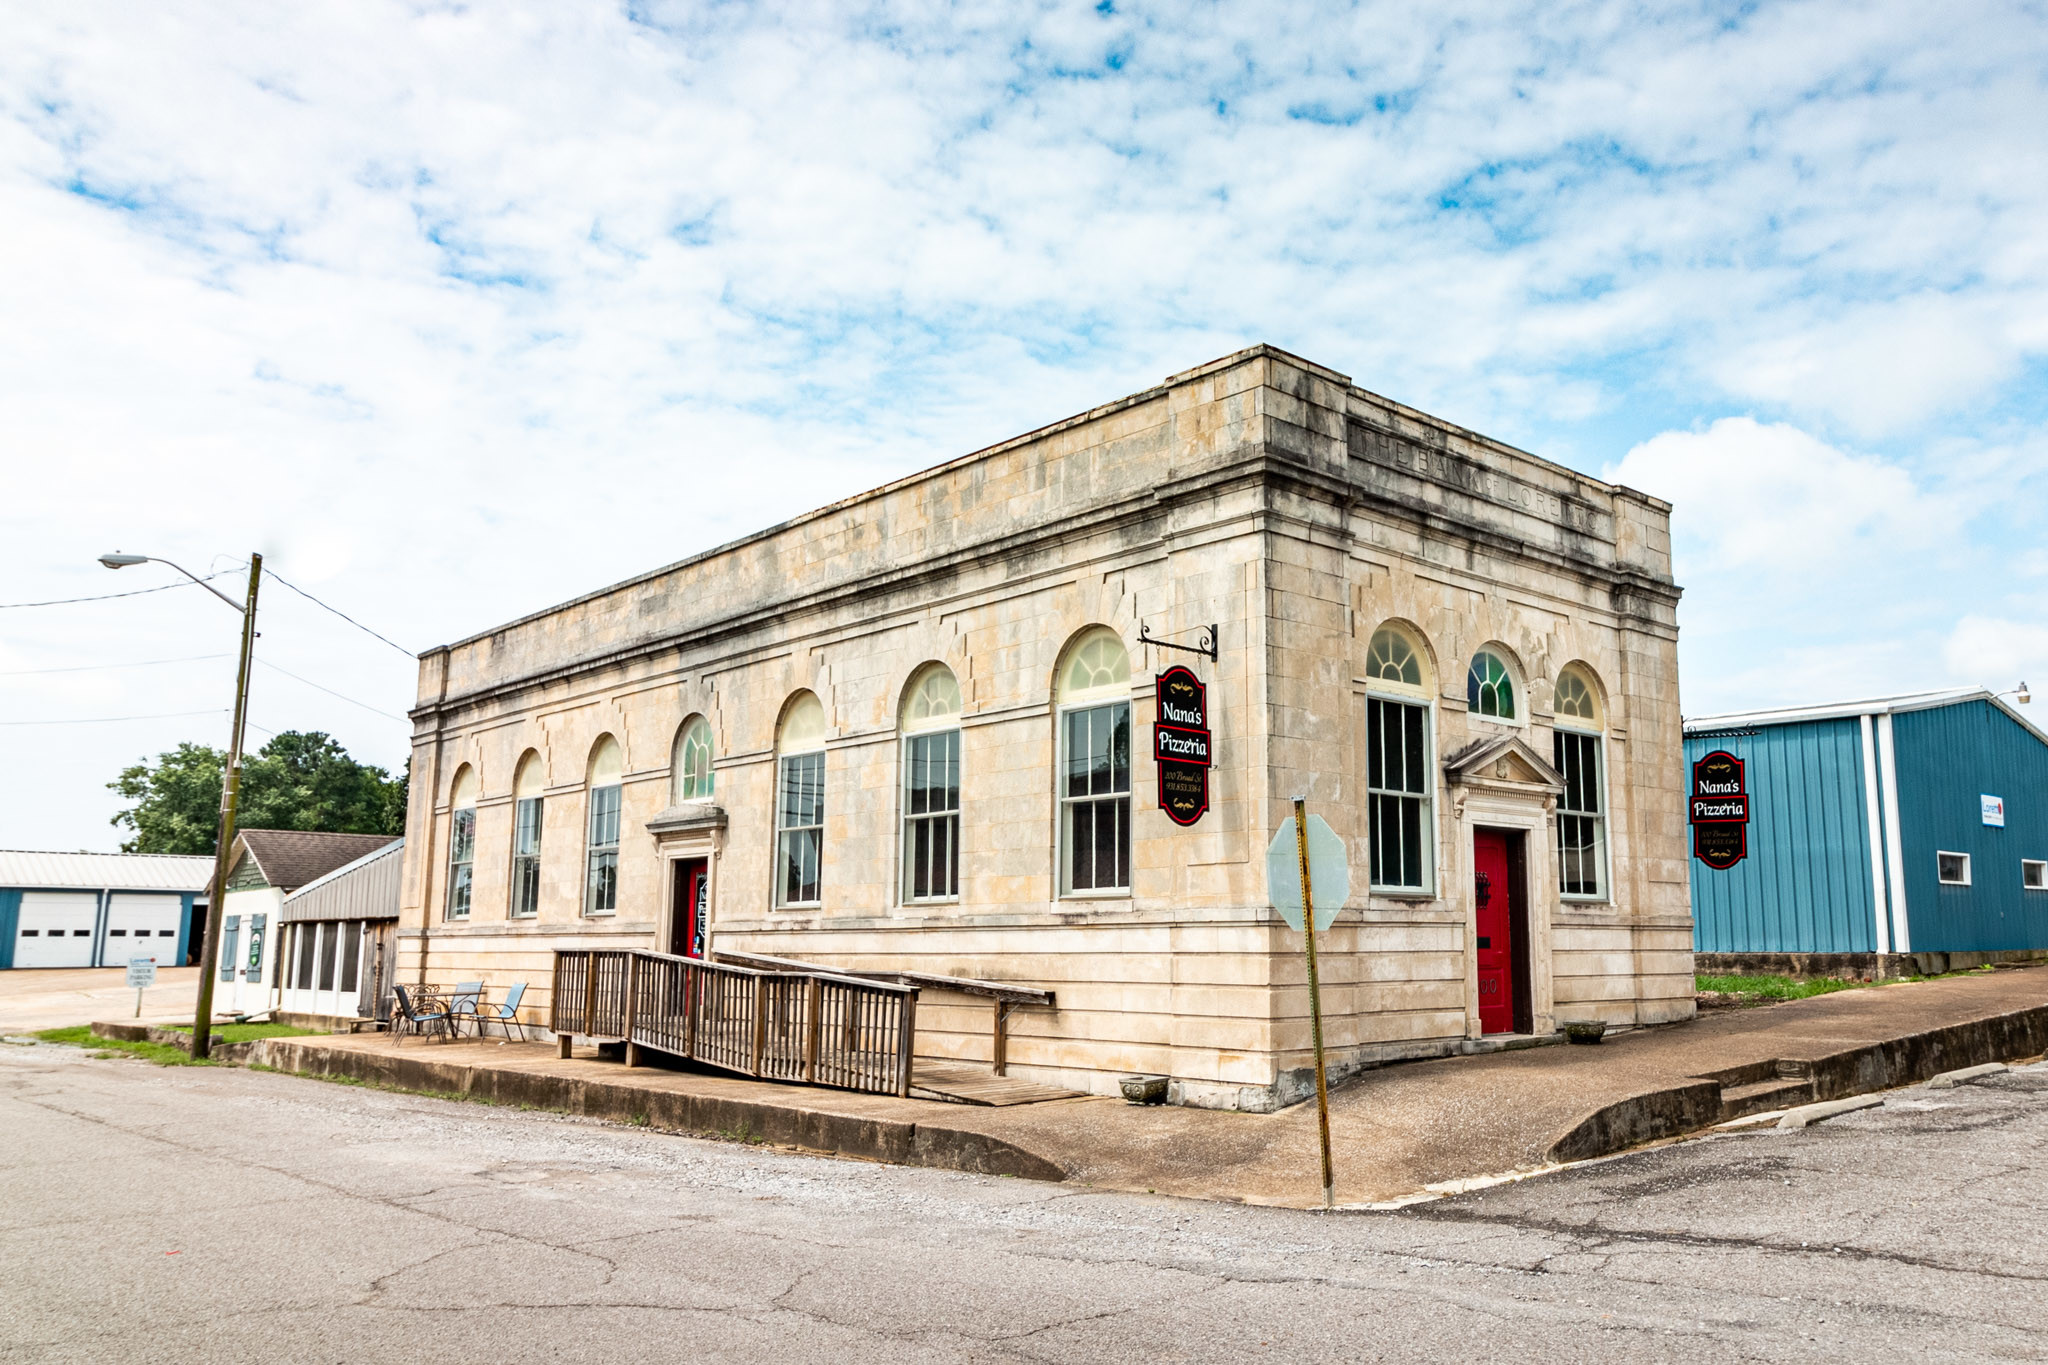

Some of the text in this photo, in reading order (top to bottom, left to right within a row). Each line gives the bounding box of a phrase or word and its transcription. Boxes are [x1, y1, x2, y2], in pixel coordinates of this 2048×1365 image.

[1359, 429, 1597, 530] THE BANK OF LORETTO
[1162, 701, 1202, 725] Nana's
[1159, 731, 1207, 756] Pizzeria
[1699, 779, 1740, 794] Nana's
[1693, 802, 1744, 816] Pizzeria
